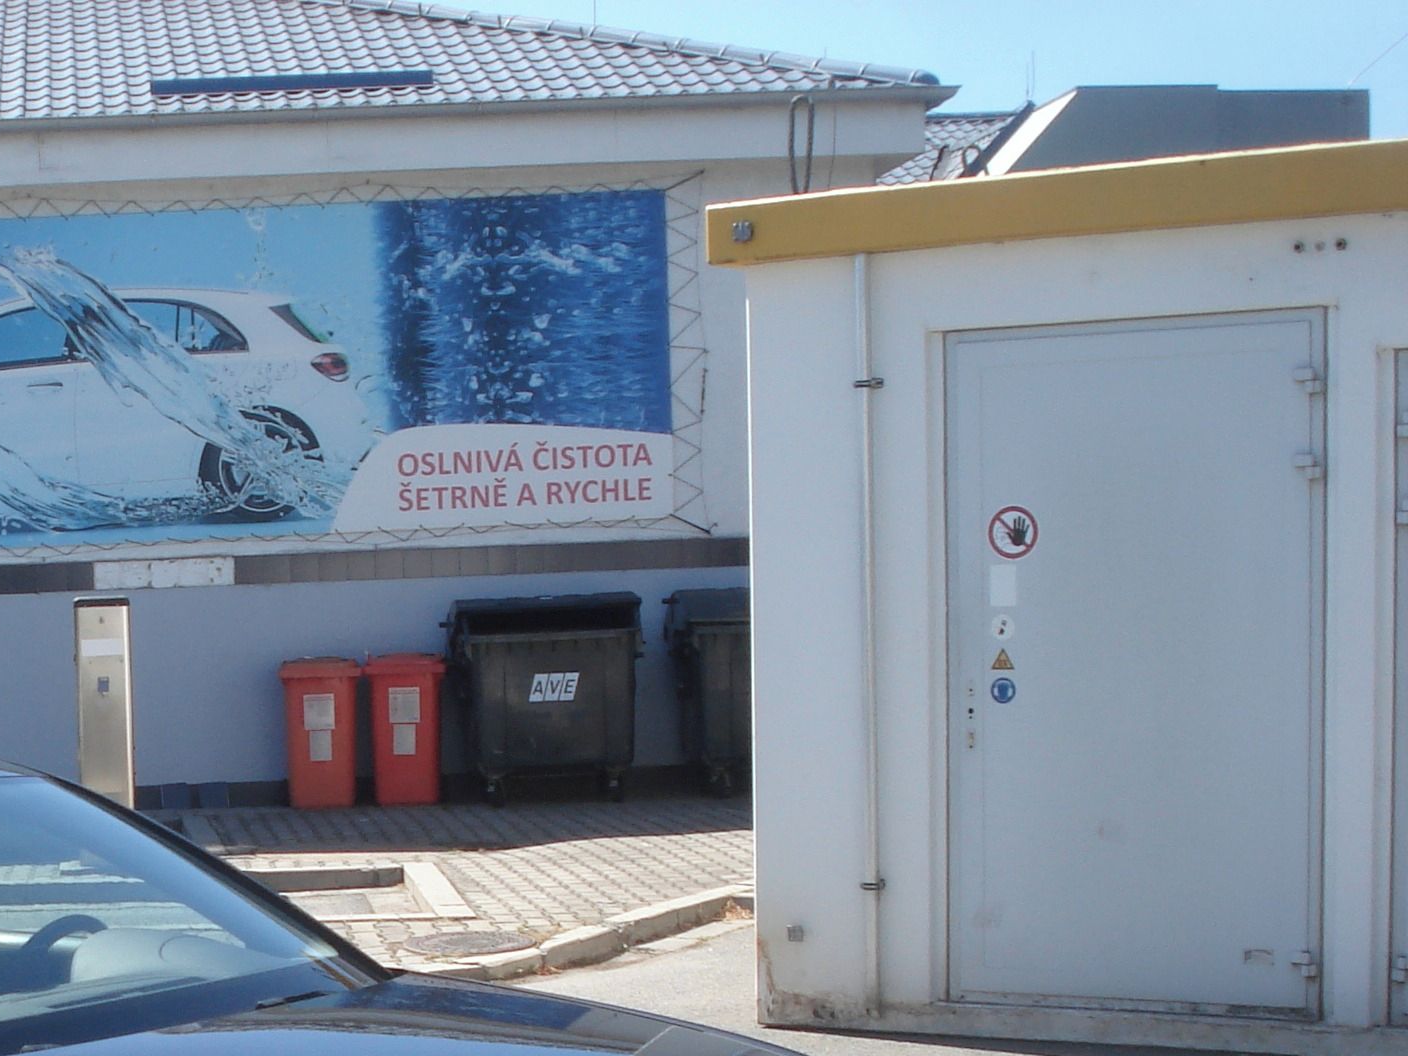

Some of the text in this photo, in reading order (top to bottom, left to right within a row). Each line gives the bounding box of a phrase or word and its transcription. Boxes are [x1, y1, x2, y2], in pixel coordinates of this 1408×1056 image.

[397, 441, 653, 477] OSLNIVÁ ČISTOTA
[398, 478, 652, 512] ŠETRNĚ A RYCHLE
[532, 679, 576, 695] AVE
